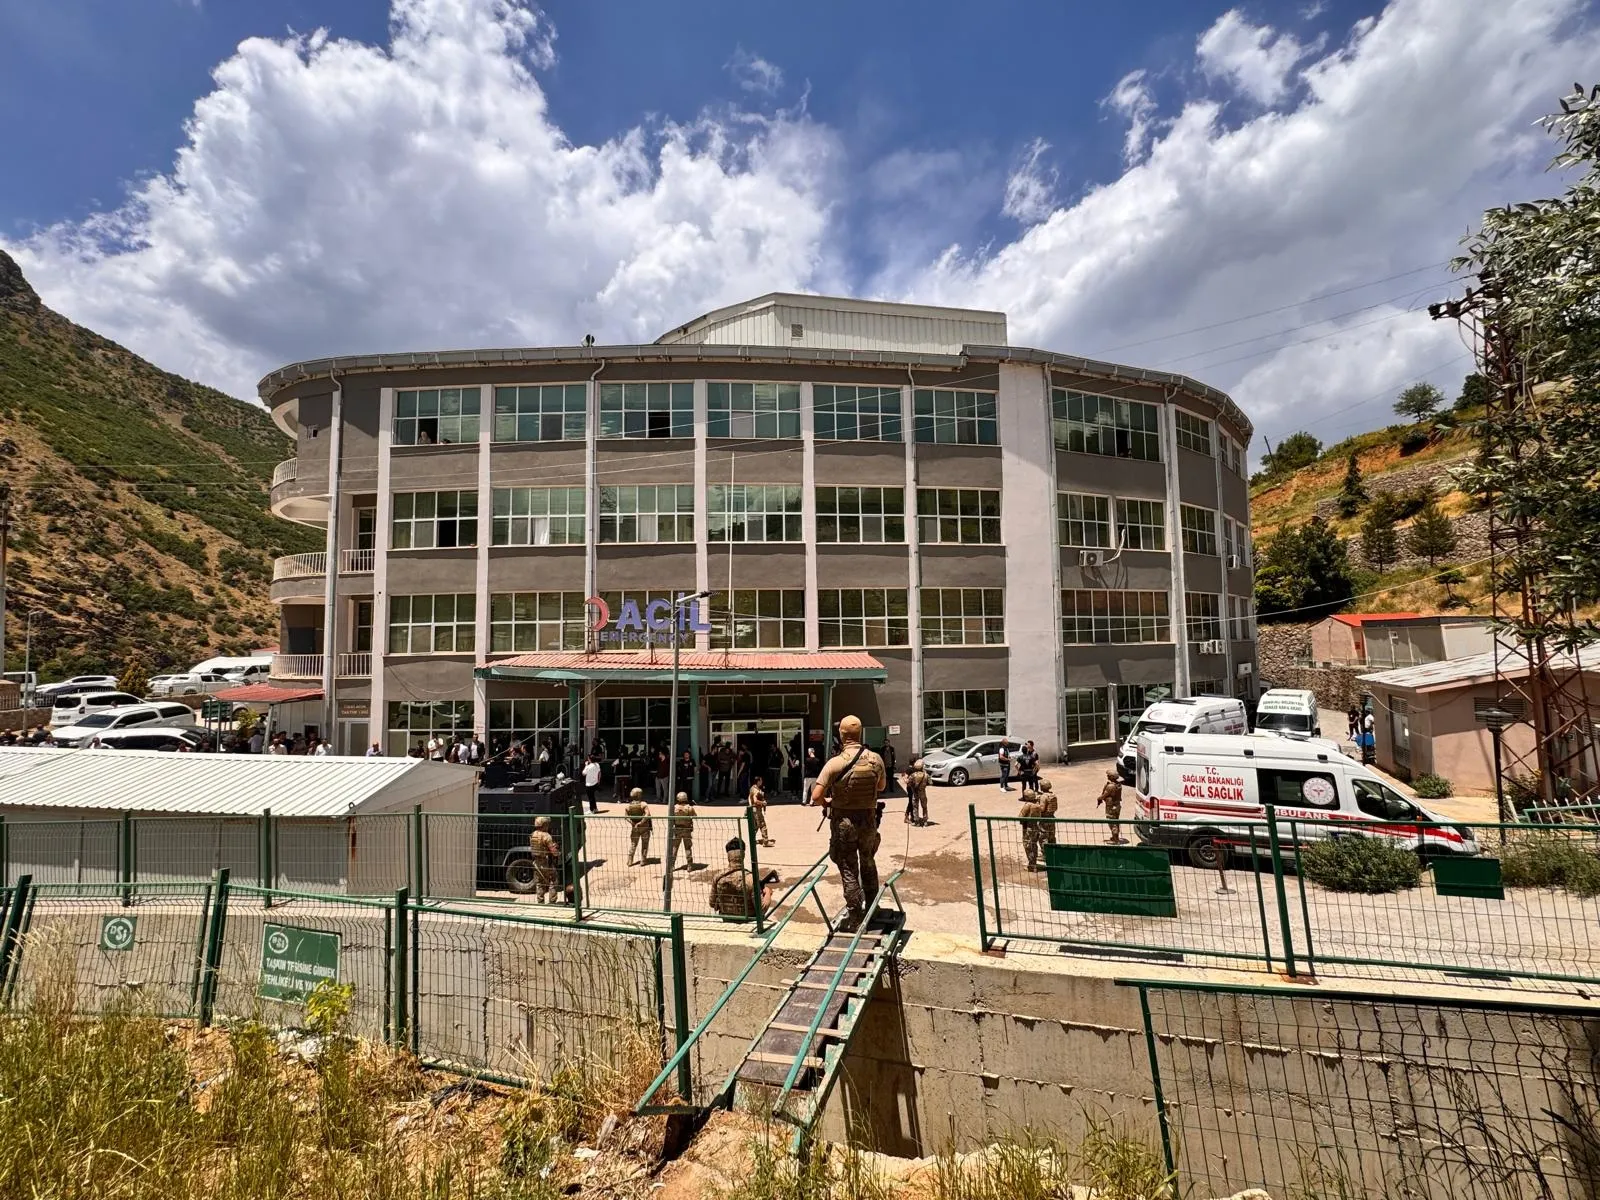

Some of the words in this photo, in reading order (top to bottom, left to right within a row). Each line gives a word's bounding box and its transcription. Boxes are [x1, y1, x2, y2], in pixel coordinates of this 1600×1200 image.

[600, 631, 689, 644] EMERGENCY
[1205, 767, 1219, 775] T.C.
[1182, 774, 1206, 783] SAĞLIK
[1207, 776, 1244, 786] BAKANLIĞI
[1207, 785, 1244, 800] SAĞLIK
[295, 979, 305, 990] VE
